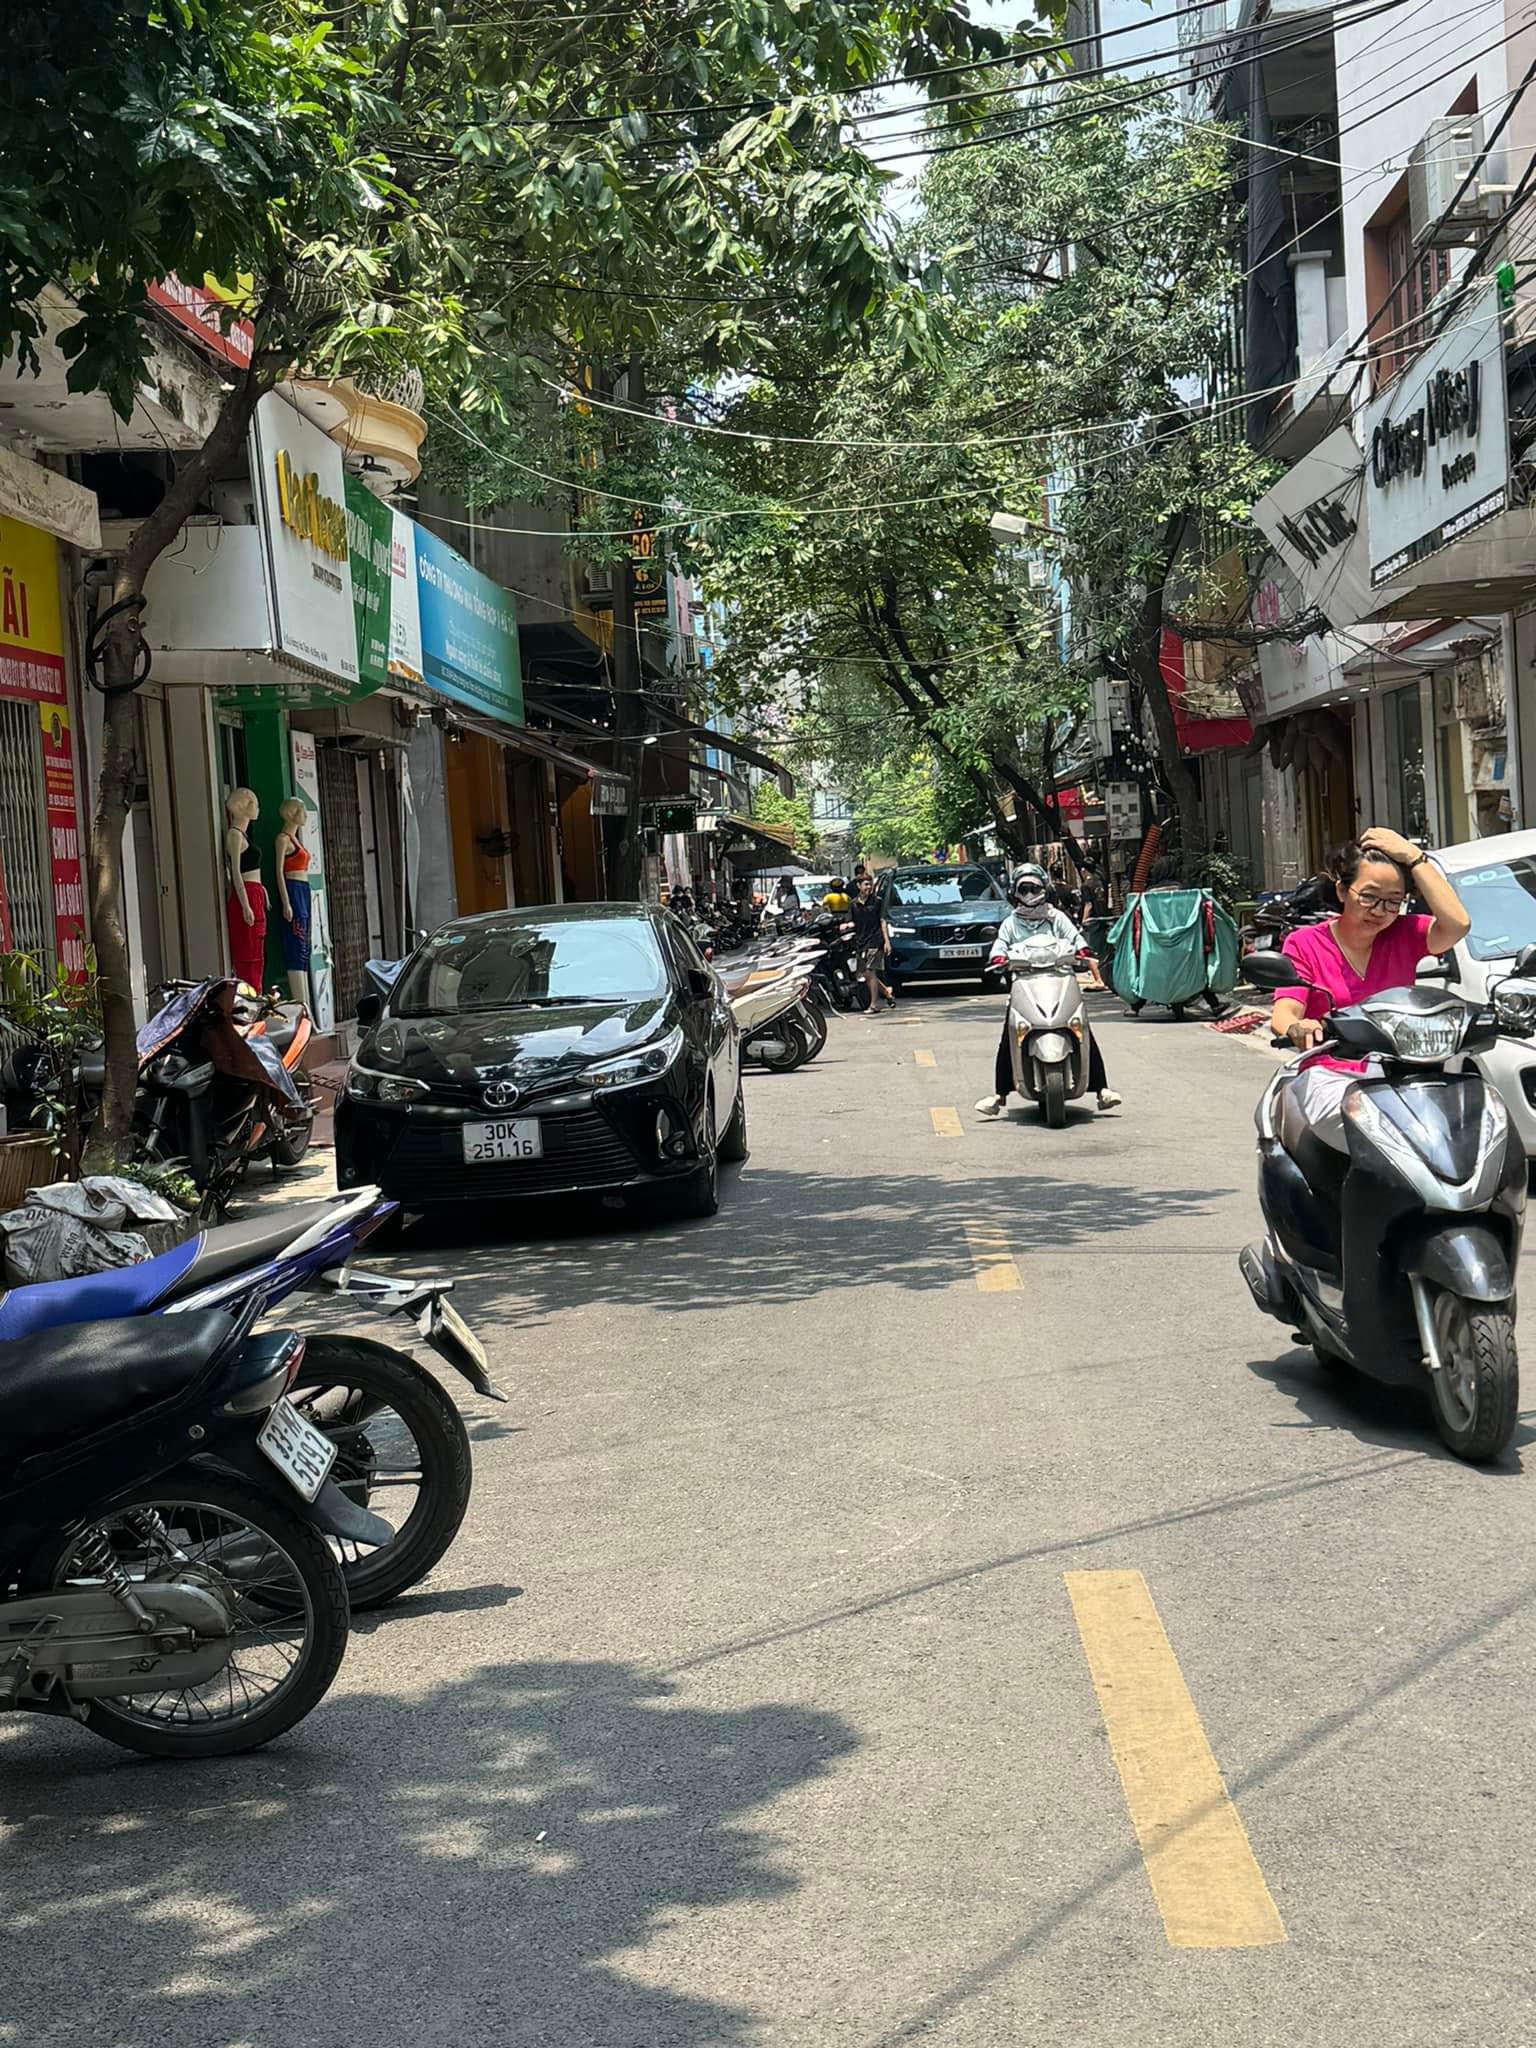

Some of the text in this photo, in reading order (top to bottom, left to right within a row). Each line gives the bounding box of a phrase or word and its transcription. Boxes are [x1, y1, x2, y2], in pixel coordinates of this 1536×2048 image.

[485, 1123, 517, 1140] 30K
[473, 1140, 533, 1160] 251.16
[291, 1430, 332, 1488] 5892
